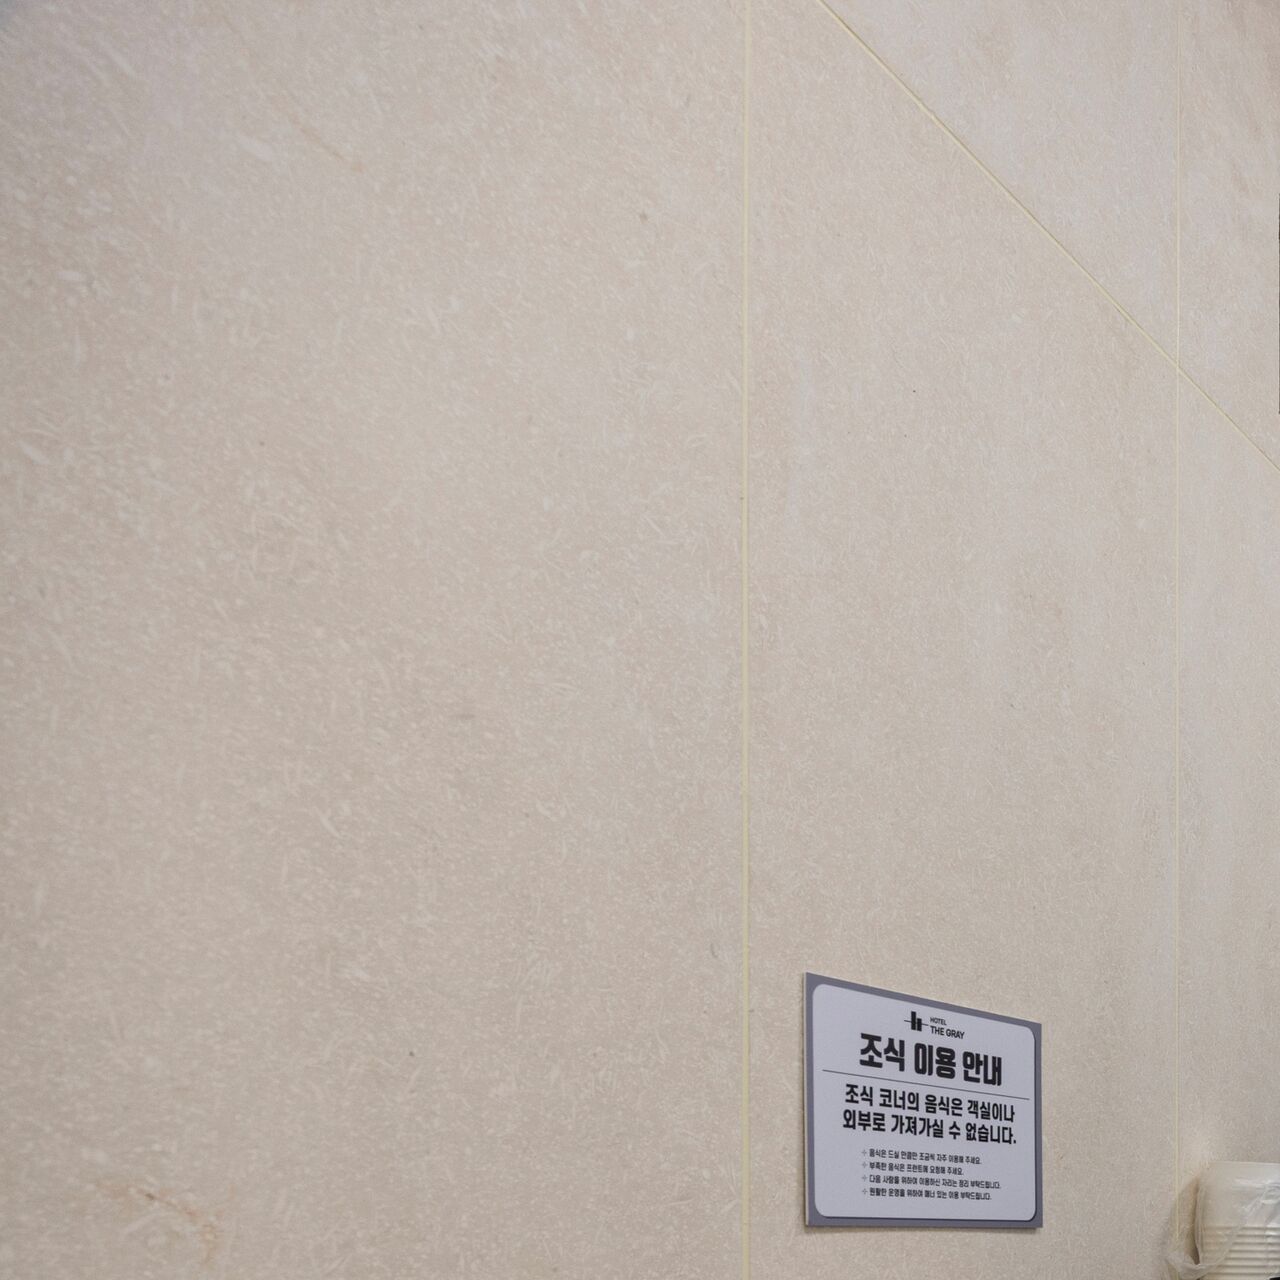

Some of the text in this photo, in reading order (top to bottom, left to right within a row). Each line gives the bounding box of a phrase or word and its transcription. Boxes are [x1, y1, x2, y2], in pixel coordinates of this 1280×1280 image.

[930, 1016, 947, 1026] HOTEL
[930, 1026, 966, 1040] THE GRAY
[859, 1032, 1002, 1086] 조식 이용 안내
[845, 1083, 1016, 1123] 조식 코너의 음식은 객실이나
[842, 1108, 1017, 1145] 외부로 가져가실 수 없습니다.
[869, 1174, 881, 1184] 다음
